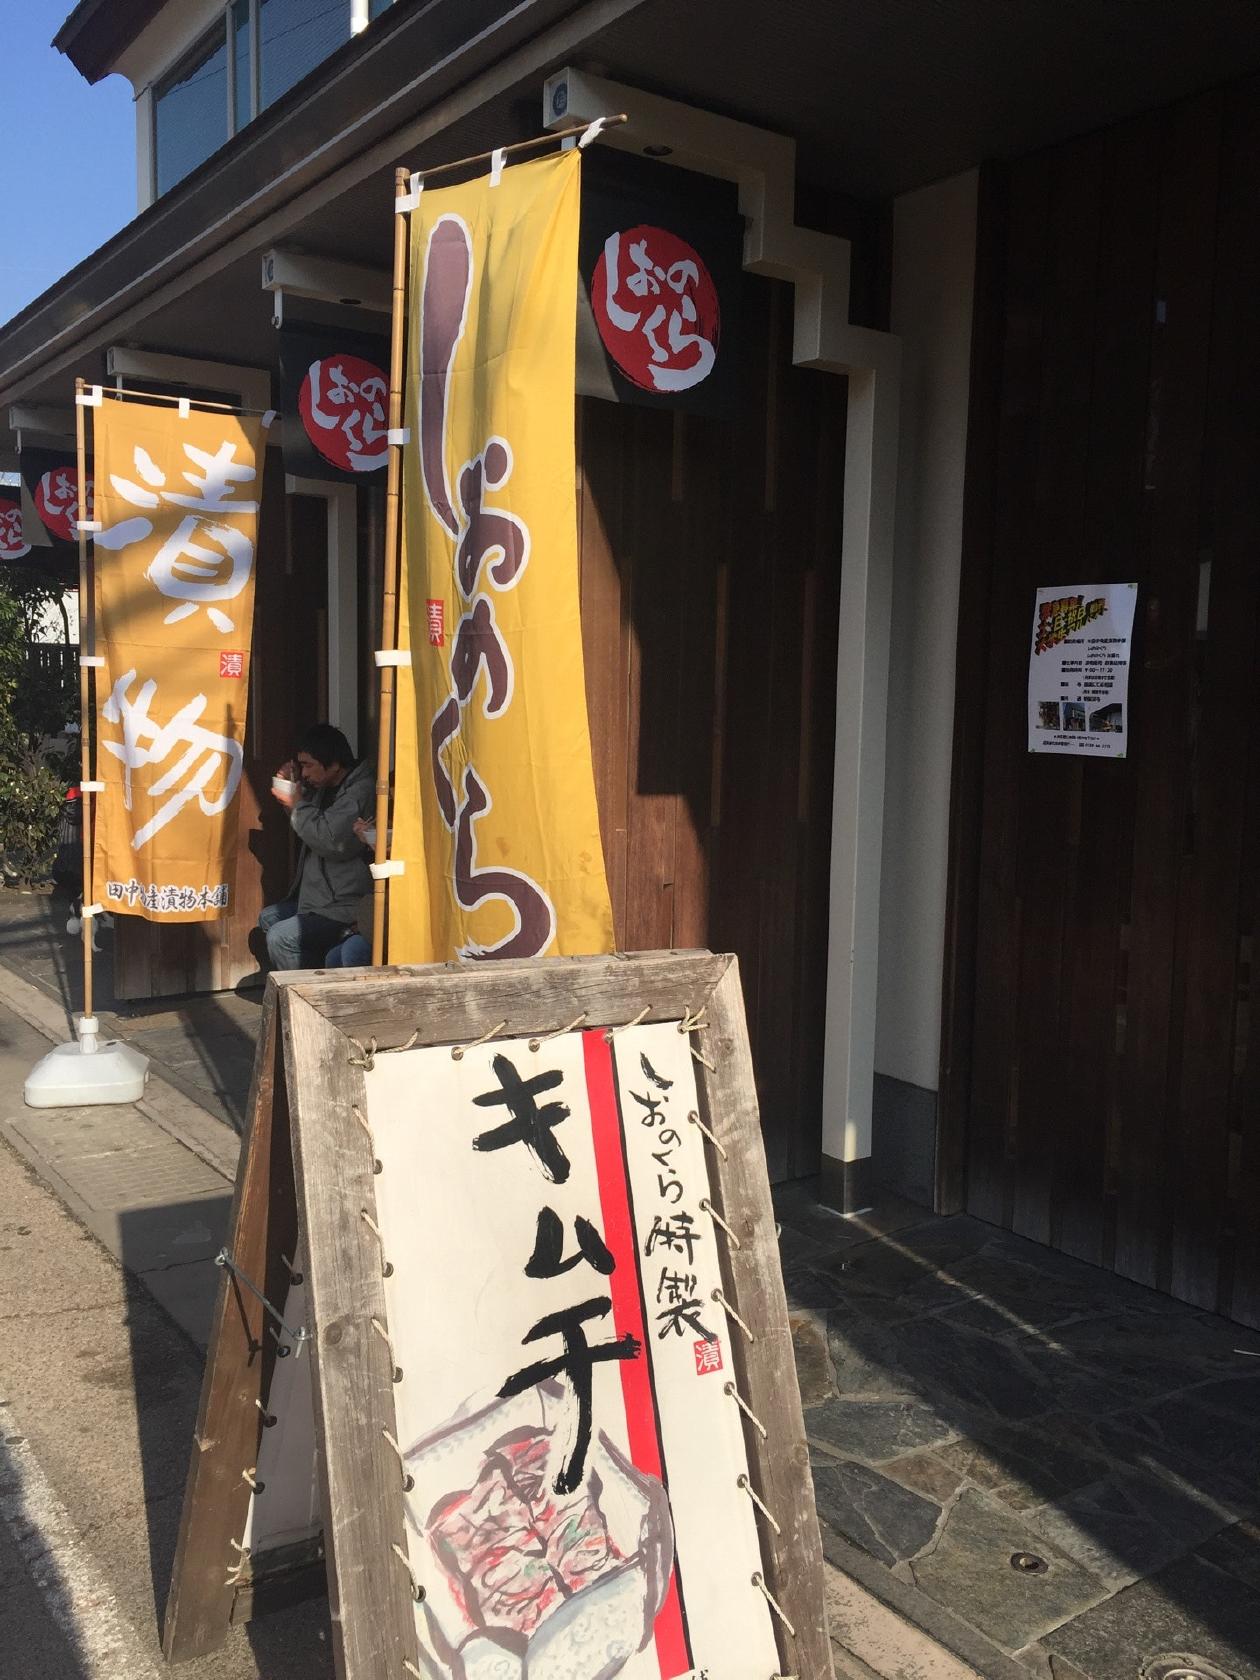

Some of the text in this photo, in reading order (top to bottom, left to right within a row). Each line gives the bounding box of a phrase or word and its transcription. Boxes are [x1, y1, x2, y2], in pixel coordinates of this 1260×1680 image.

[603, 231, 716, 391] しおのくら
[94, 440, 260, 850] 漬物
[220, 652, 243, 677] 漬
[472, 1052, 643, 1496] キムチ
[695, 1341, 723, 1376] 漬
